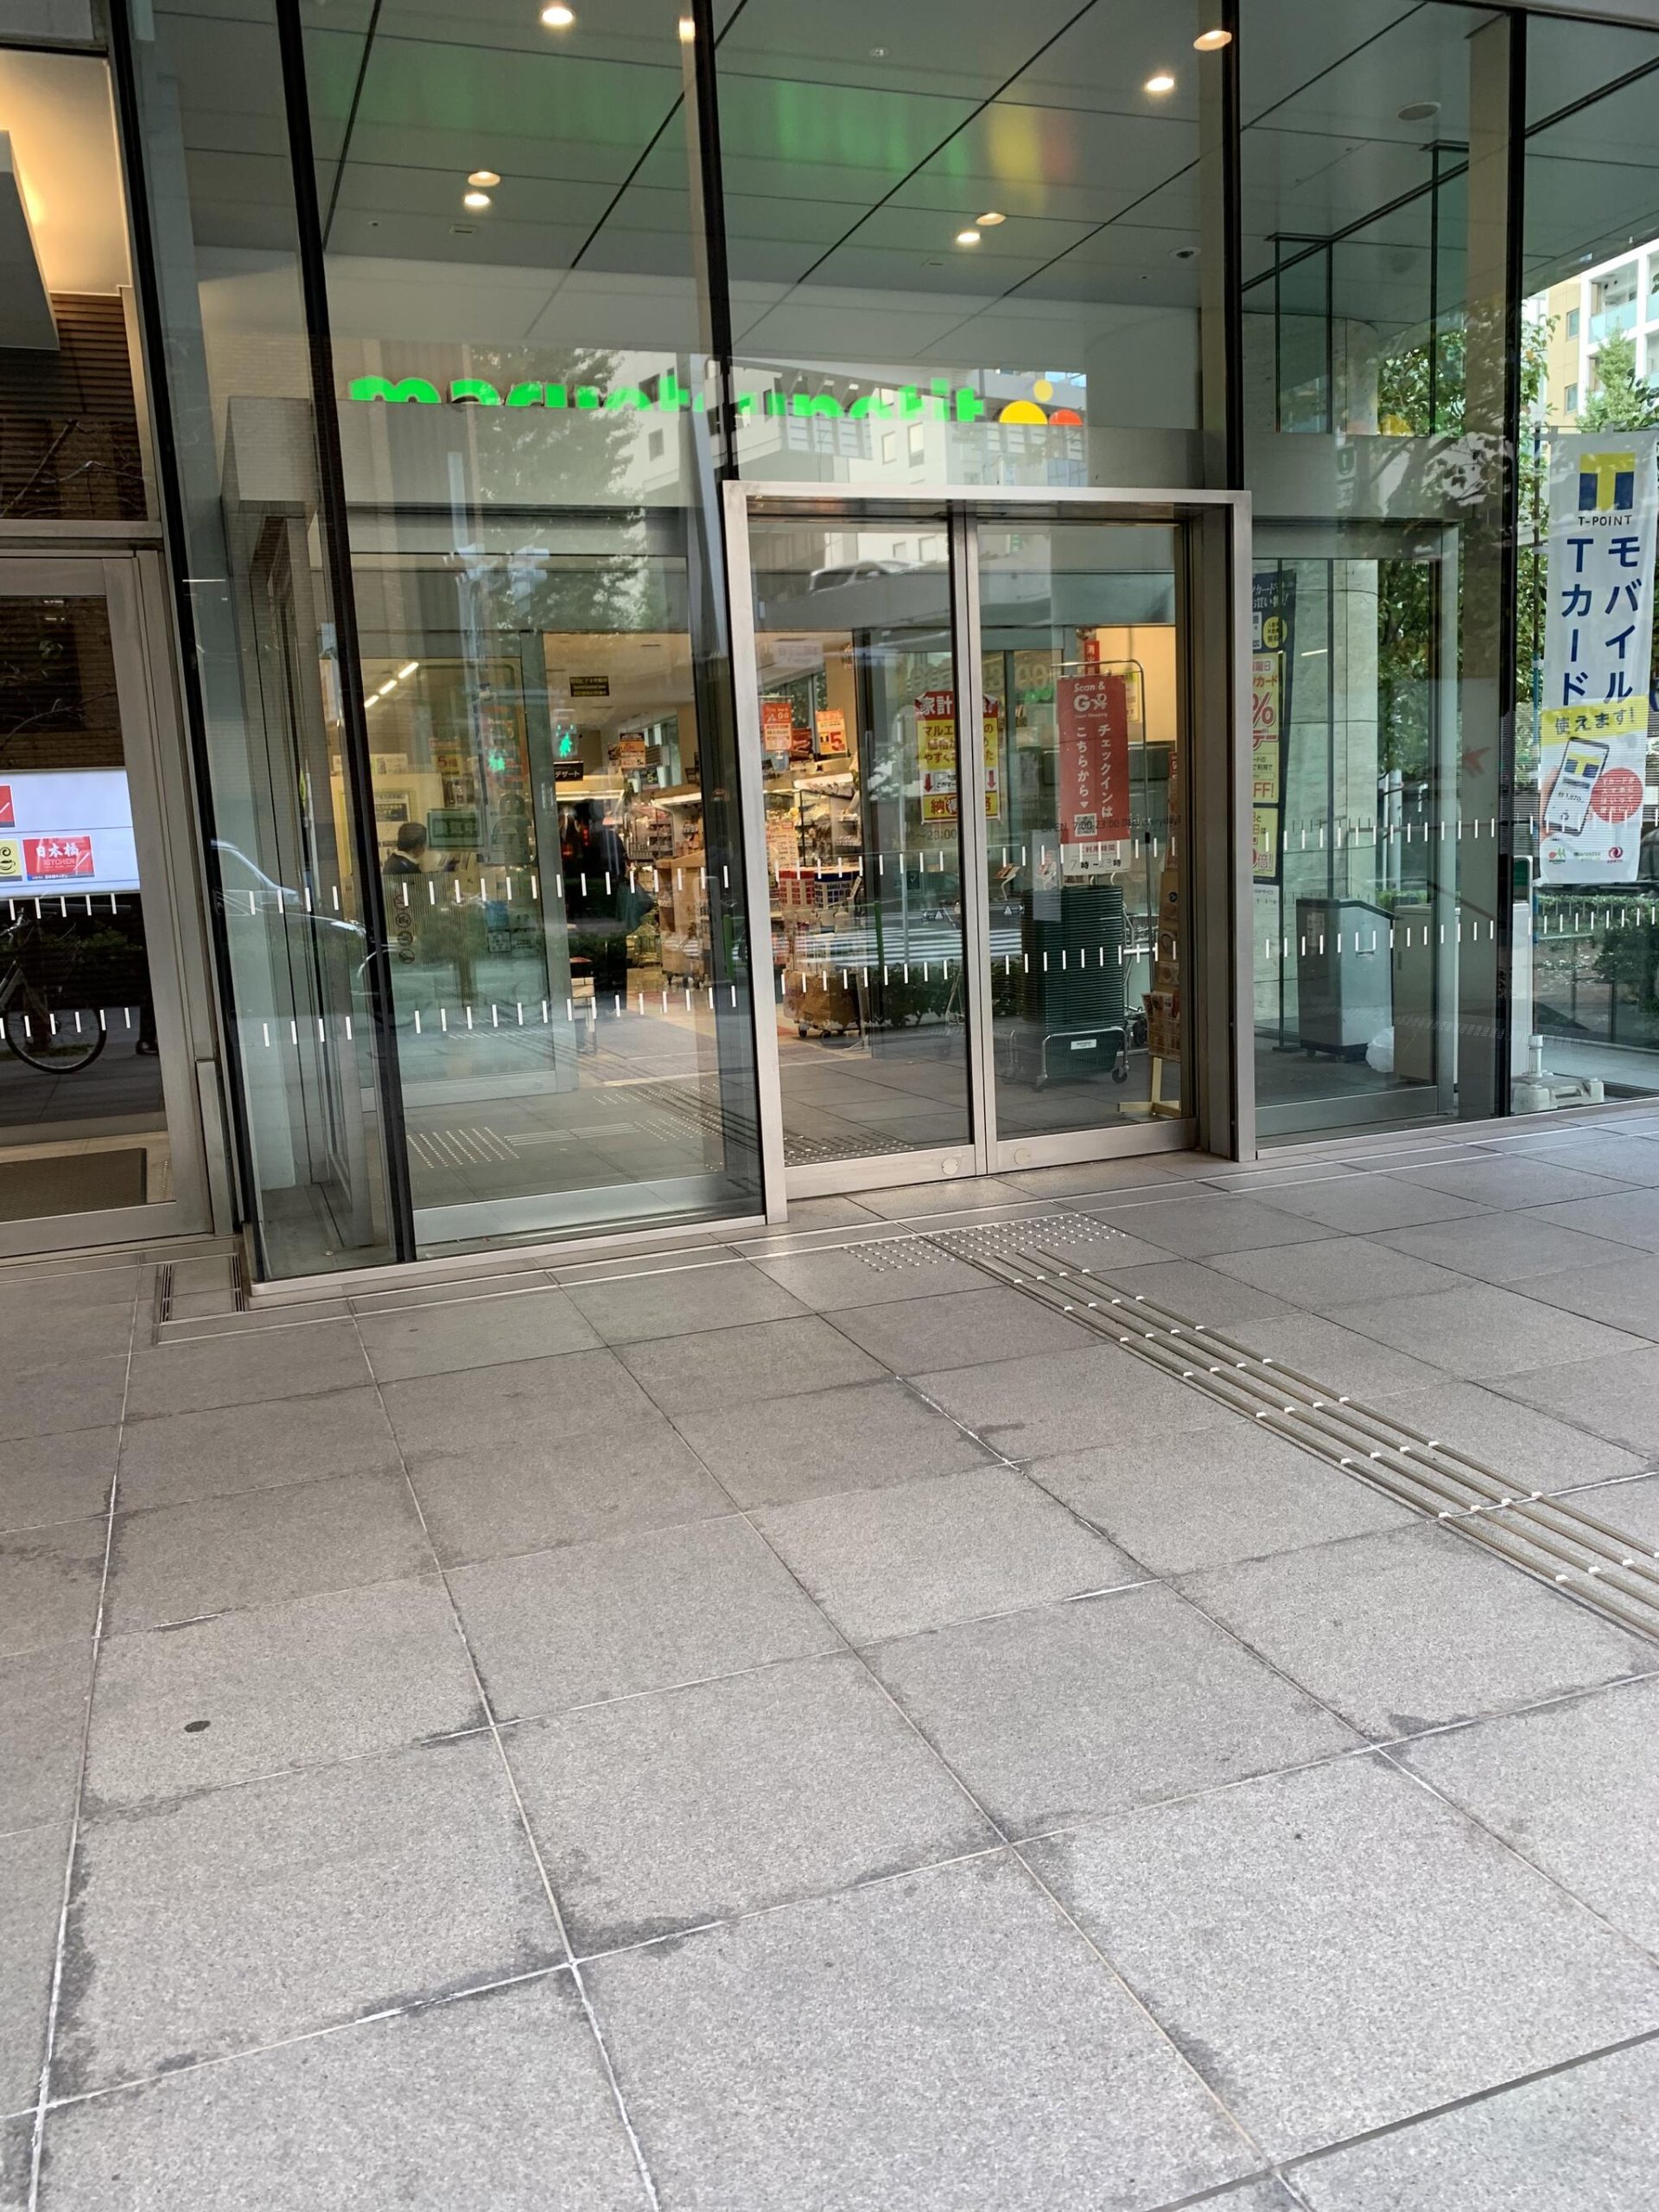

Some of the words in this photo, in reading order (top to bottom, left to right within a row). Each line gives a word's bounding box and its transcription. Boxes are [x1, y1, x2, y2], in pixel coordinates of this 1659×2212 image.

[1578, 515, 1632, 526] T-POINT
[1561, 537, 1593, 706] Tカード
[1604, 536, 1643, 704] モバイル
[1074, 683, 1096, 693] Scan
[1077, 726, 1090, 797] こちらから
[1098, 723, 1114, 817] チェックインは
[35, 842, 79, 858] 日本橋
